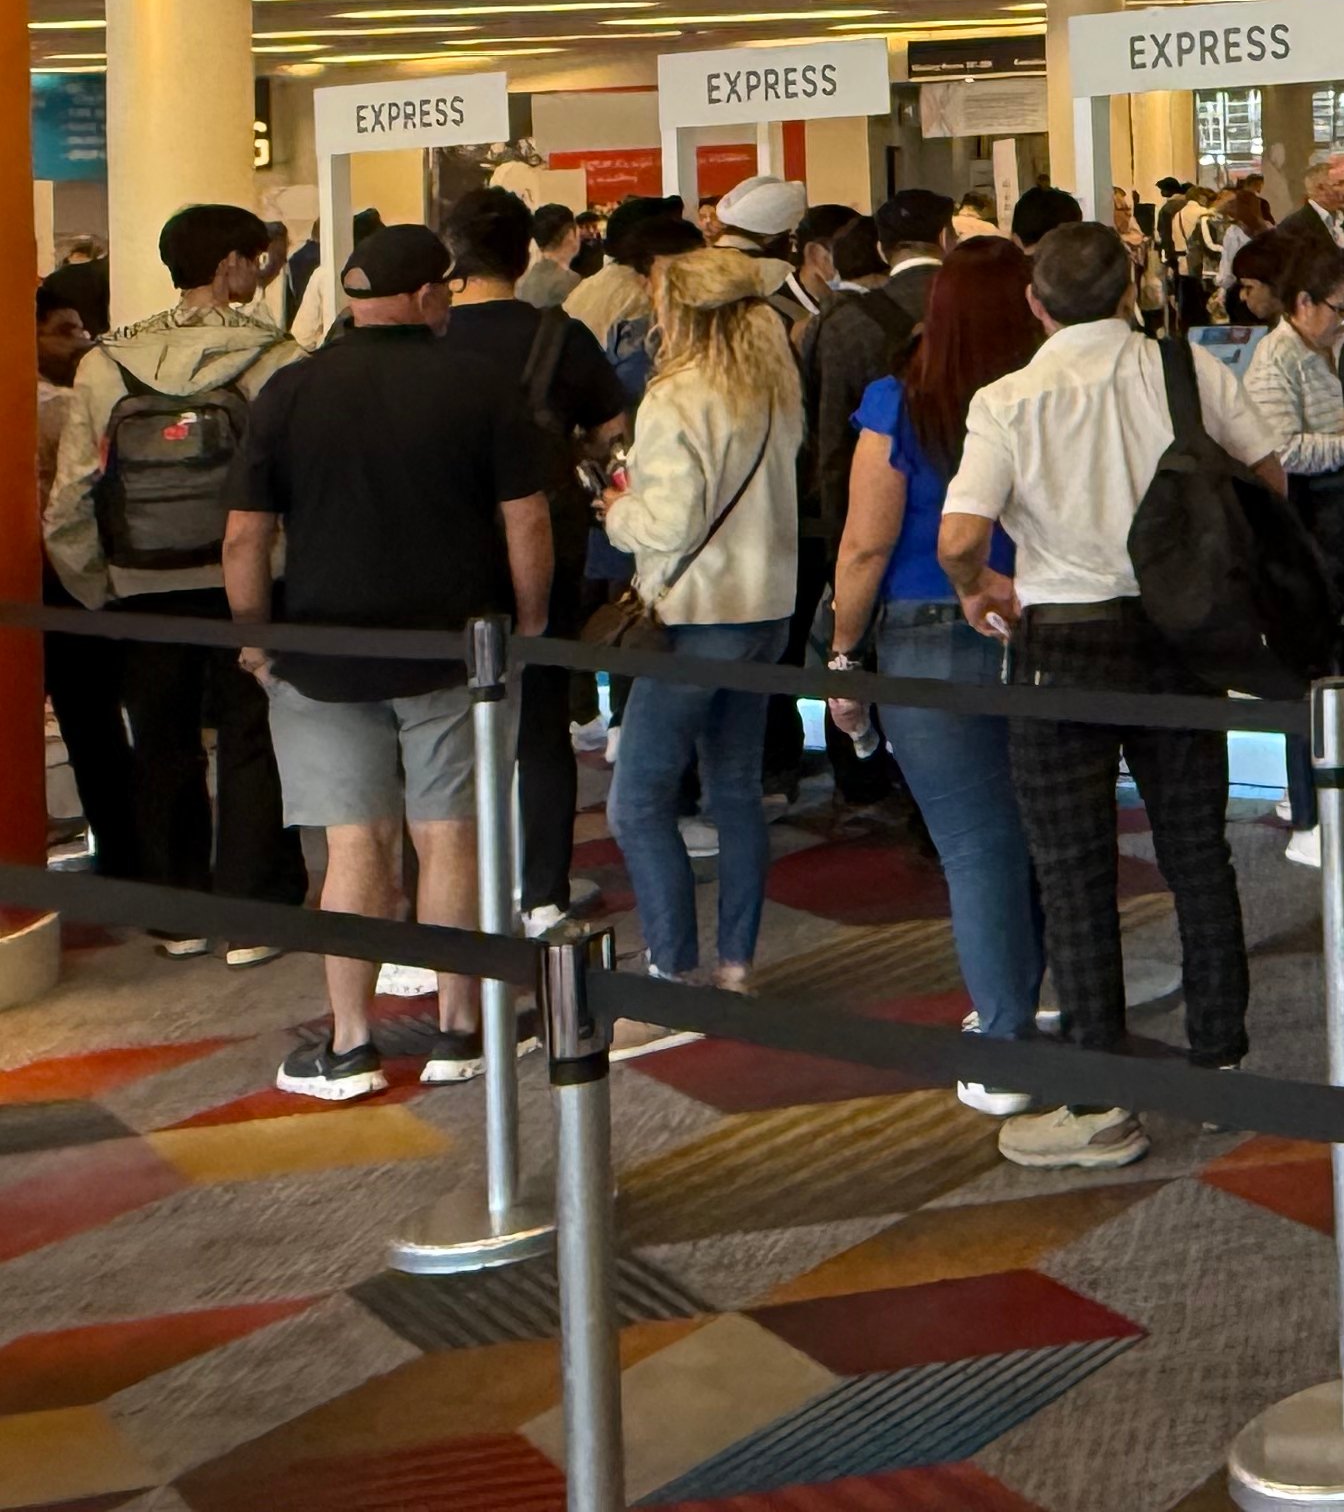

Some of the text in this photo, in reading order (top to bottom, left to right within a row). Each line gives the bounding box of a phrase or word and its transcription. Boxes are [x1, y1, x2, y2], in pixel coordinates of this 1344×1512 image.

[1129, 23, 1291, 71] EXPRESS
[706, 63, 839, 105] EXPRESS
[356, 95, 467, 135] EXPRESS
